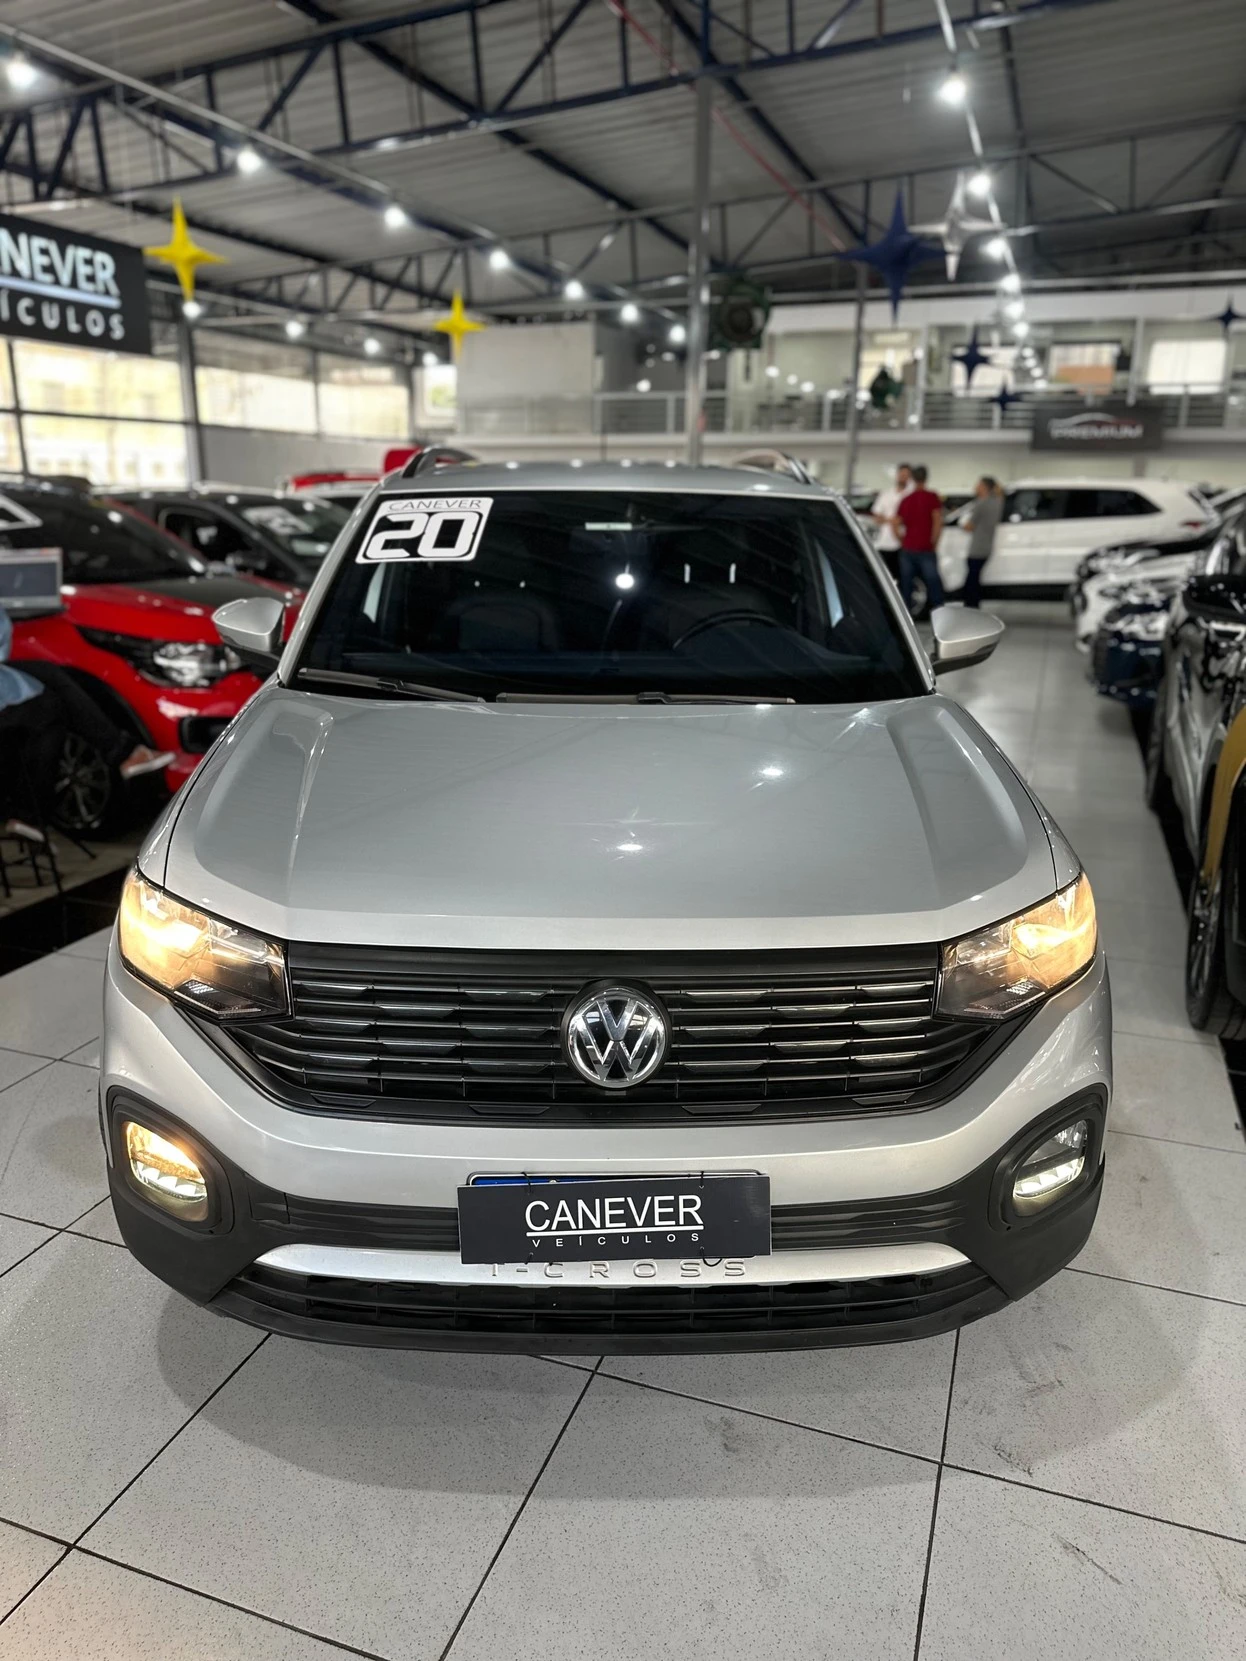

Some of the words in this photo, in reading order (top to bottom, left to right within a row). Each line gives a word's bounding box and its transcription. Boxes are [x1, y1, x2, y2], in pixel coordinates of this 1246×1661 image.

[0, 228, 121, 298] NEVER
[388, 499, 482, 511] CANEVER
[365, 511, 481, 560] 20
[525, 1194, 704, 1232] CANEVER
[532, 1233, 699, 1248] VEÍCULOS
